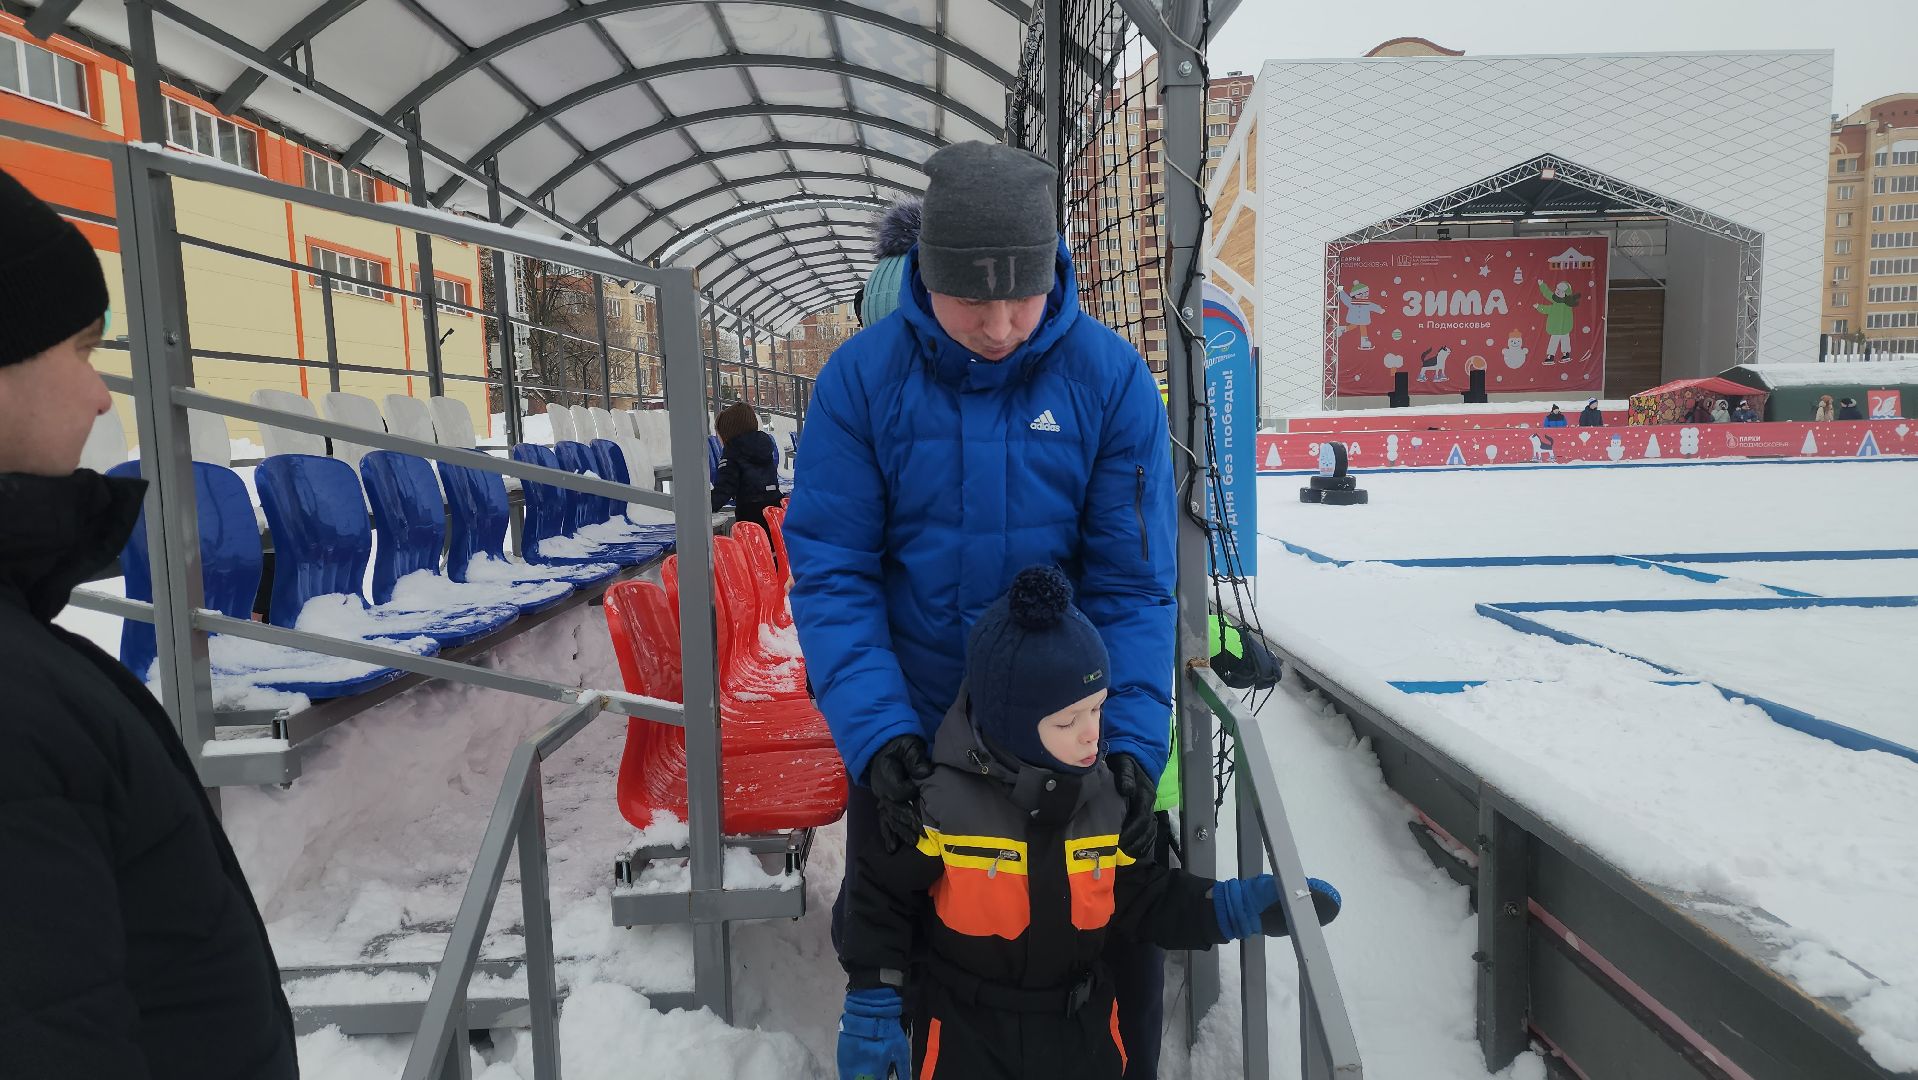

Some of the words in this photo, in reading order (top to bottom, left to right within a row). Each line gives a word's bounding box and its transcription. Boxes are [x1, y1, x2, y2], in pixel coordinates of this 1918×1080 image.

[1402, 289, 1509, 316] ЗИМА
[1427, 321, 1491, 330] Подмосковье
[1221, 369, 1235, 448] победы!
[1030, 421, 1061, 432] adidas
[1308, 441, 1362, 457] ЗА
[1222, 454, 1234, 486] без
[1225, 491, 1239, 526] дня
